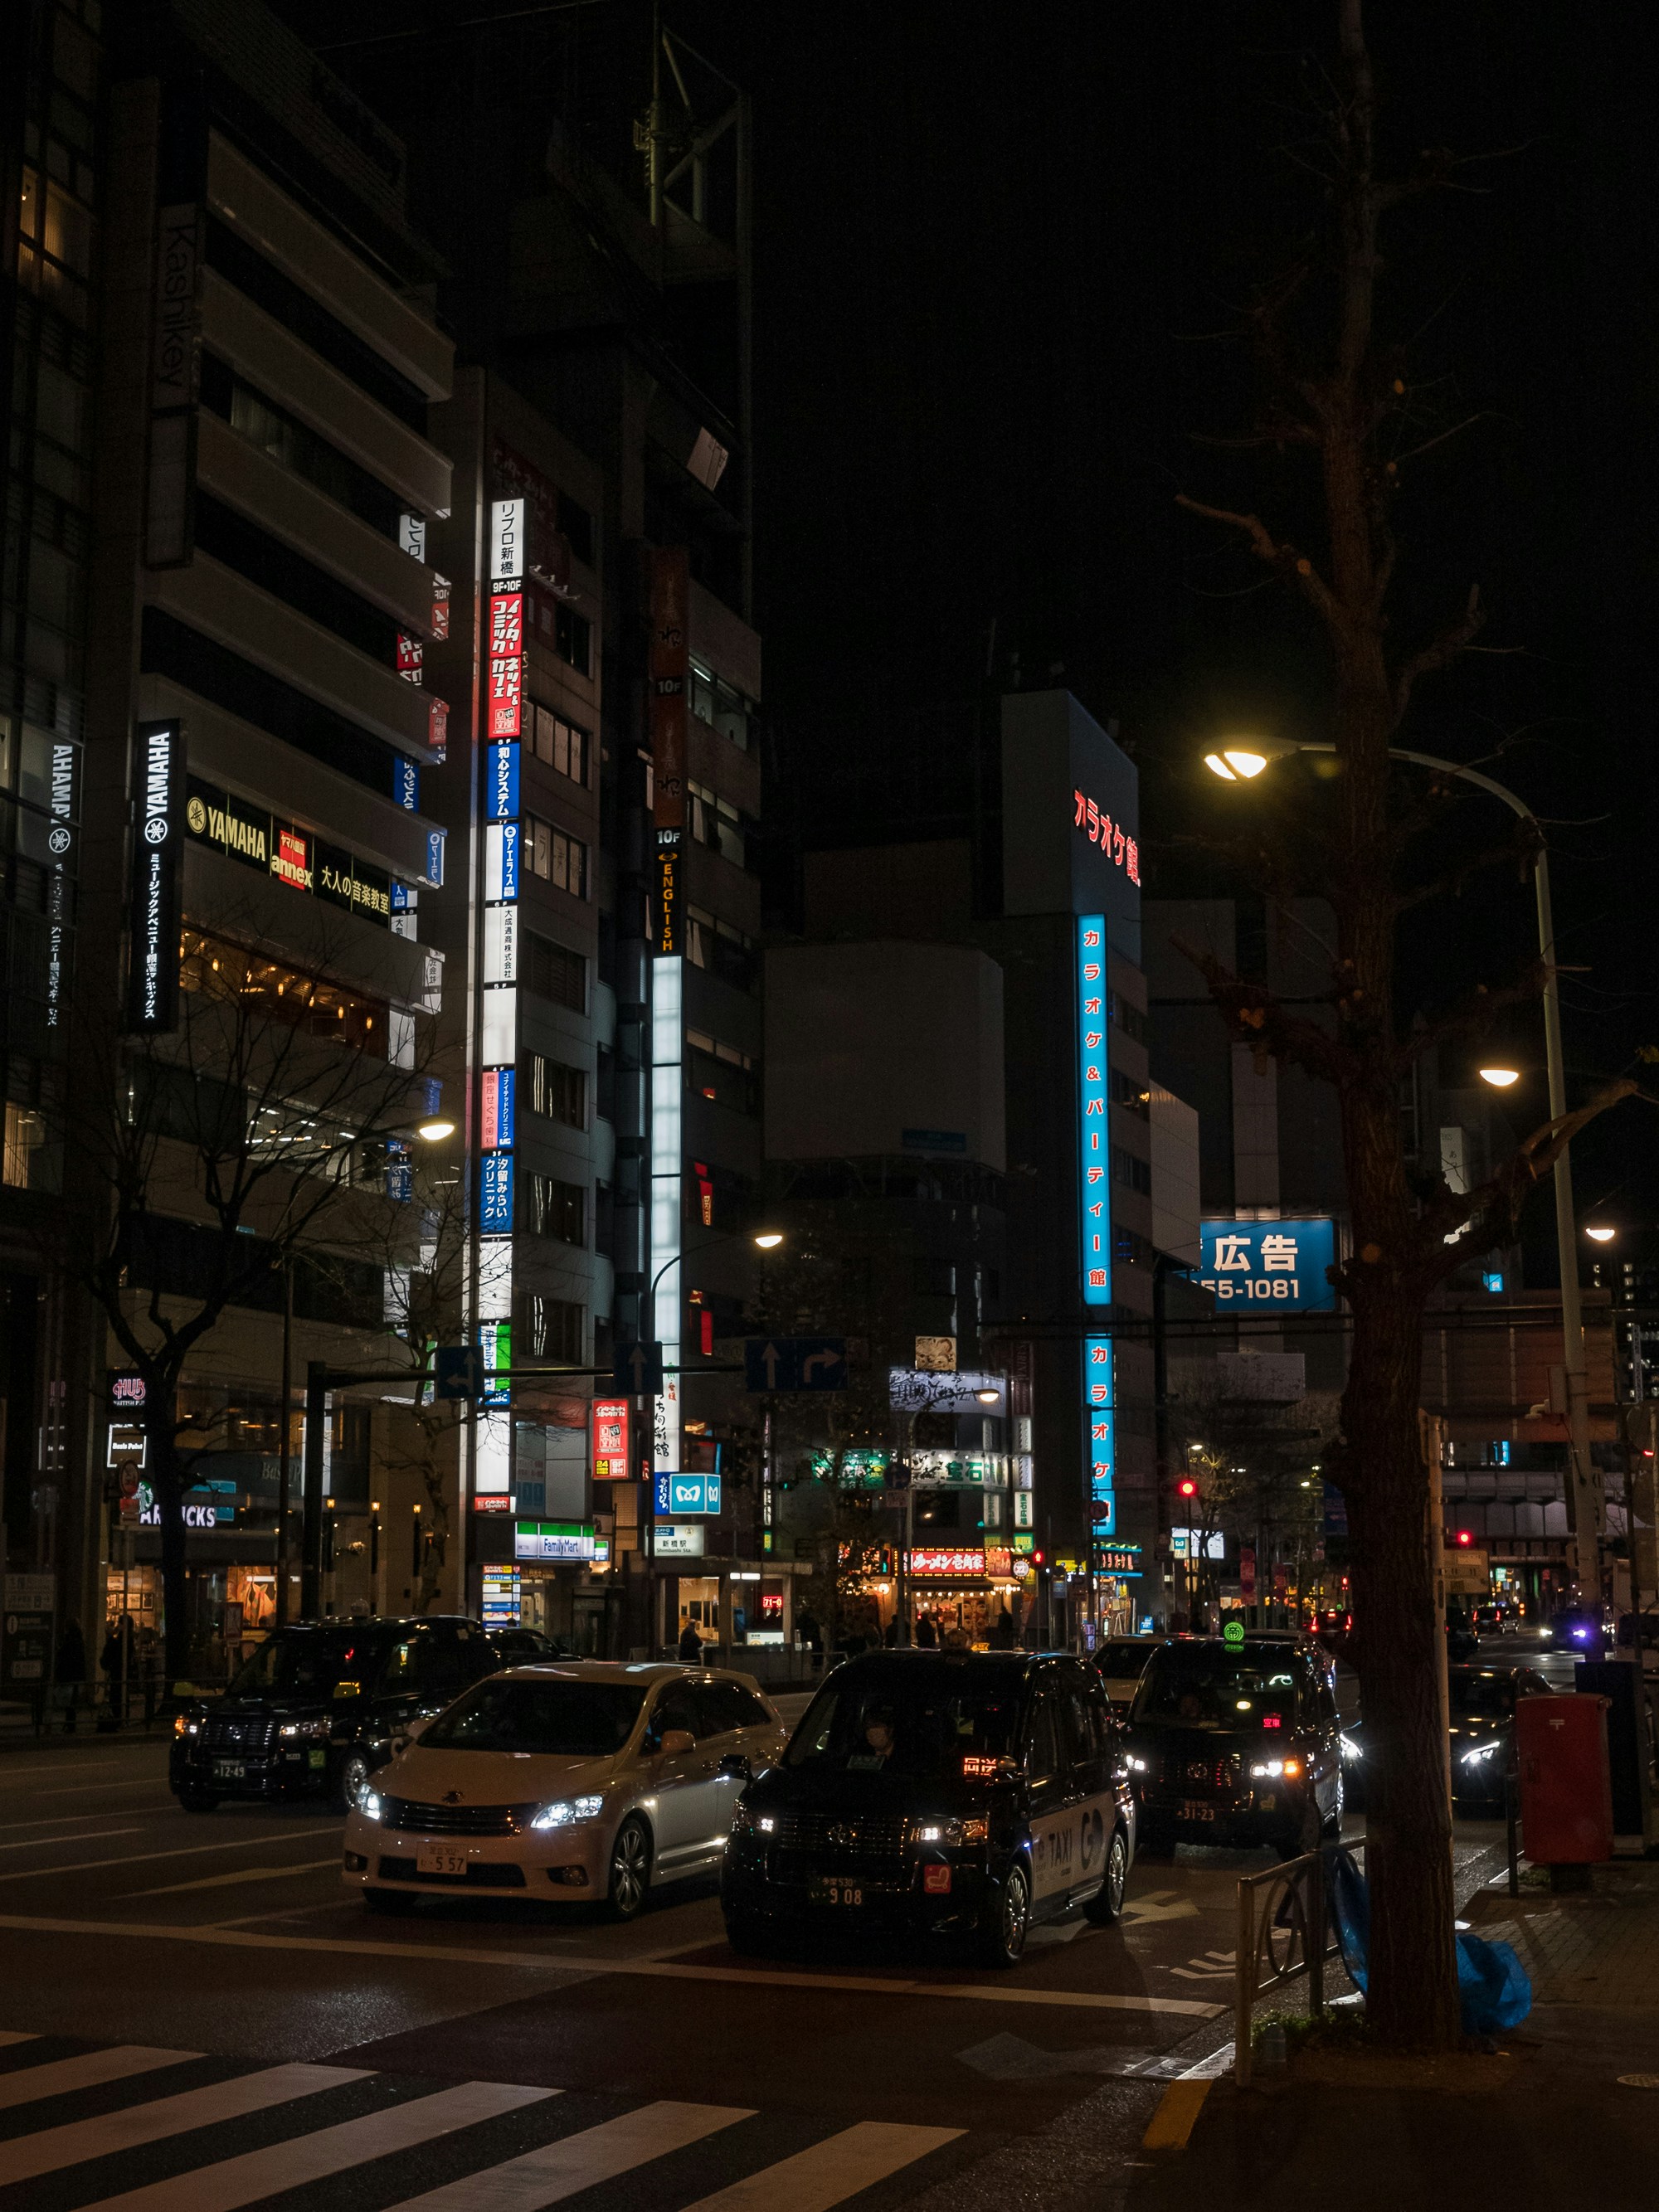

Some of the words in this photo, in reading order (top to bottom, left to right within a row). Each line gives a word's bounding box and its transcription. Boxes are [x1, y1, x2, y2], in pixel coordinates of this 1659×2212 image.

[159, 225, 198, 387] Kashikey
[146, 732, 170, 819] YAMAHA
[497, 746, 510, 816] 和心システム
[207, 806, 265, 862] YAMAHA
[657, 830, 680, 843] 10F
[1074, 790, 1138, 885] カラオケ館
[271, 854, 313, 888] annex
[505, 839, 514, 886] アエラス
[321, 865, 389, 916] 大人の音楽教室
[663, 863, 674, 951] ENGLISH
[1083, 930, 1107, 1286] カラオケ&パーティー館
[485, 1159, 495, 1218] クリニック
[497, 1158, 508, 1218] 汐留みらい
[1191, 1279, 1299, 1300] 55-1081
[113, 1378, 146, 1400] HUB
[946, 1461, 982, 1481] 宝石
[544, 1539, 578, 1555] FamilyMart
[1184, 1808, 1214, 1821] 31-23
[1048, 1828, 1072, 1869] TAXI
